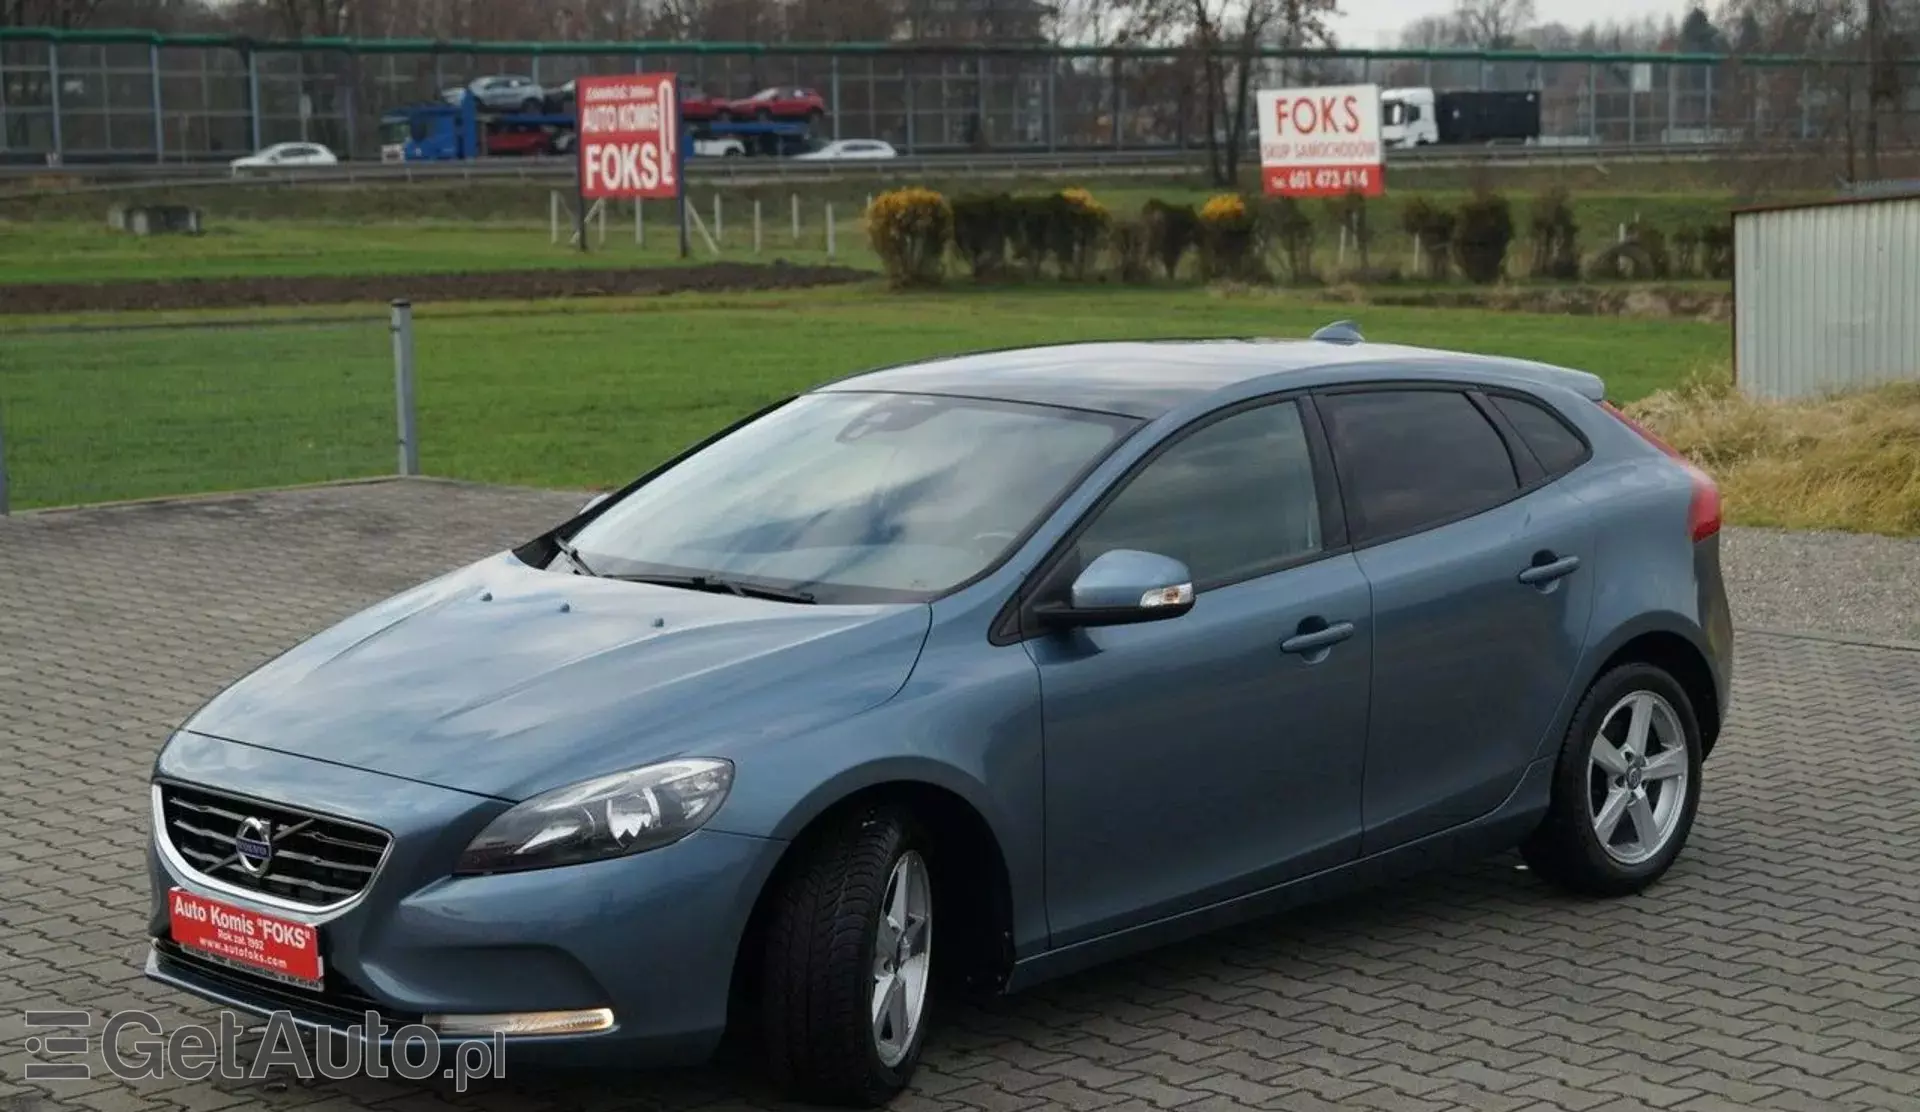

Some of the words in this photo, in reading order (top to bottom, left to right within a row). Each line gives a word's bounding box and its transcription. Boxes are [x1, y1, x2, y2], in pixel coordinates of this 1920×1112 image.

[582, 104, 617, 132] AUTO
[618, 102, 659, 131] KOMIS
[1274, 95, 1359, 136] FOKS
[585, 142, 660, 190] FOKS
[1264, 143, 1291, 159] SKUP
[174, 896, 207, 922] Auto
[210, 905, 255, 935] Komis
[217, 928, 232, 941] Rok
[199, 937, 288, 969] www.autofoks.com
